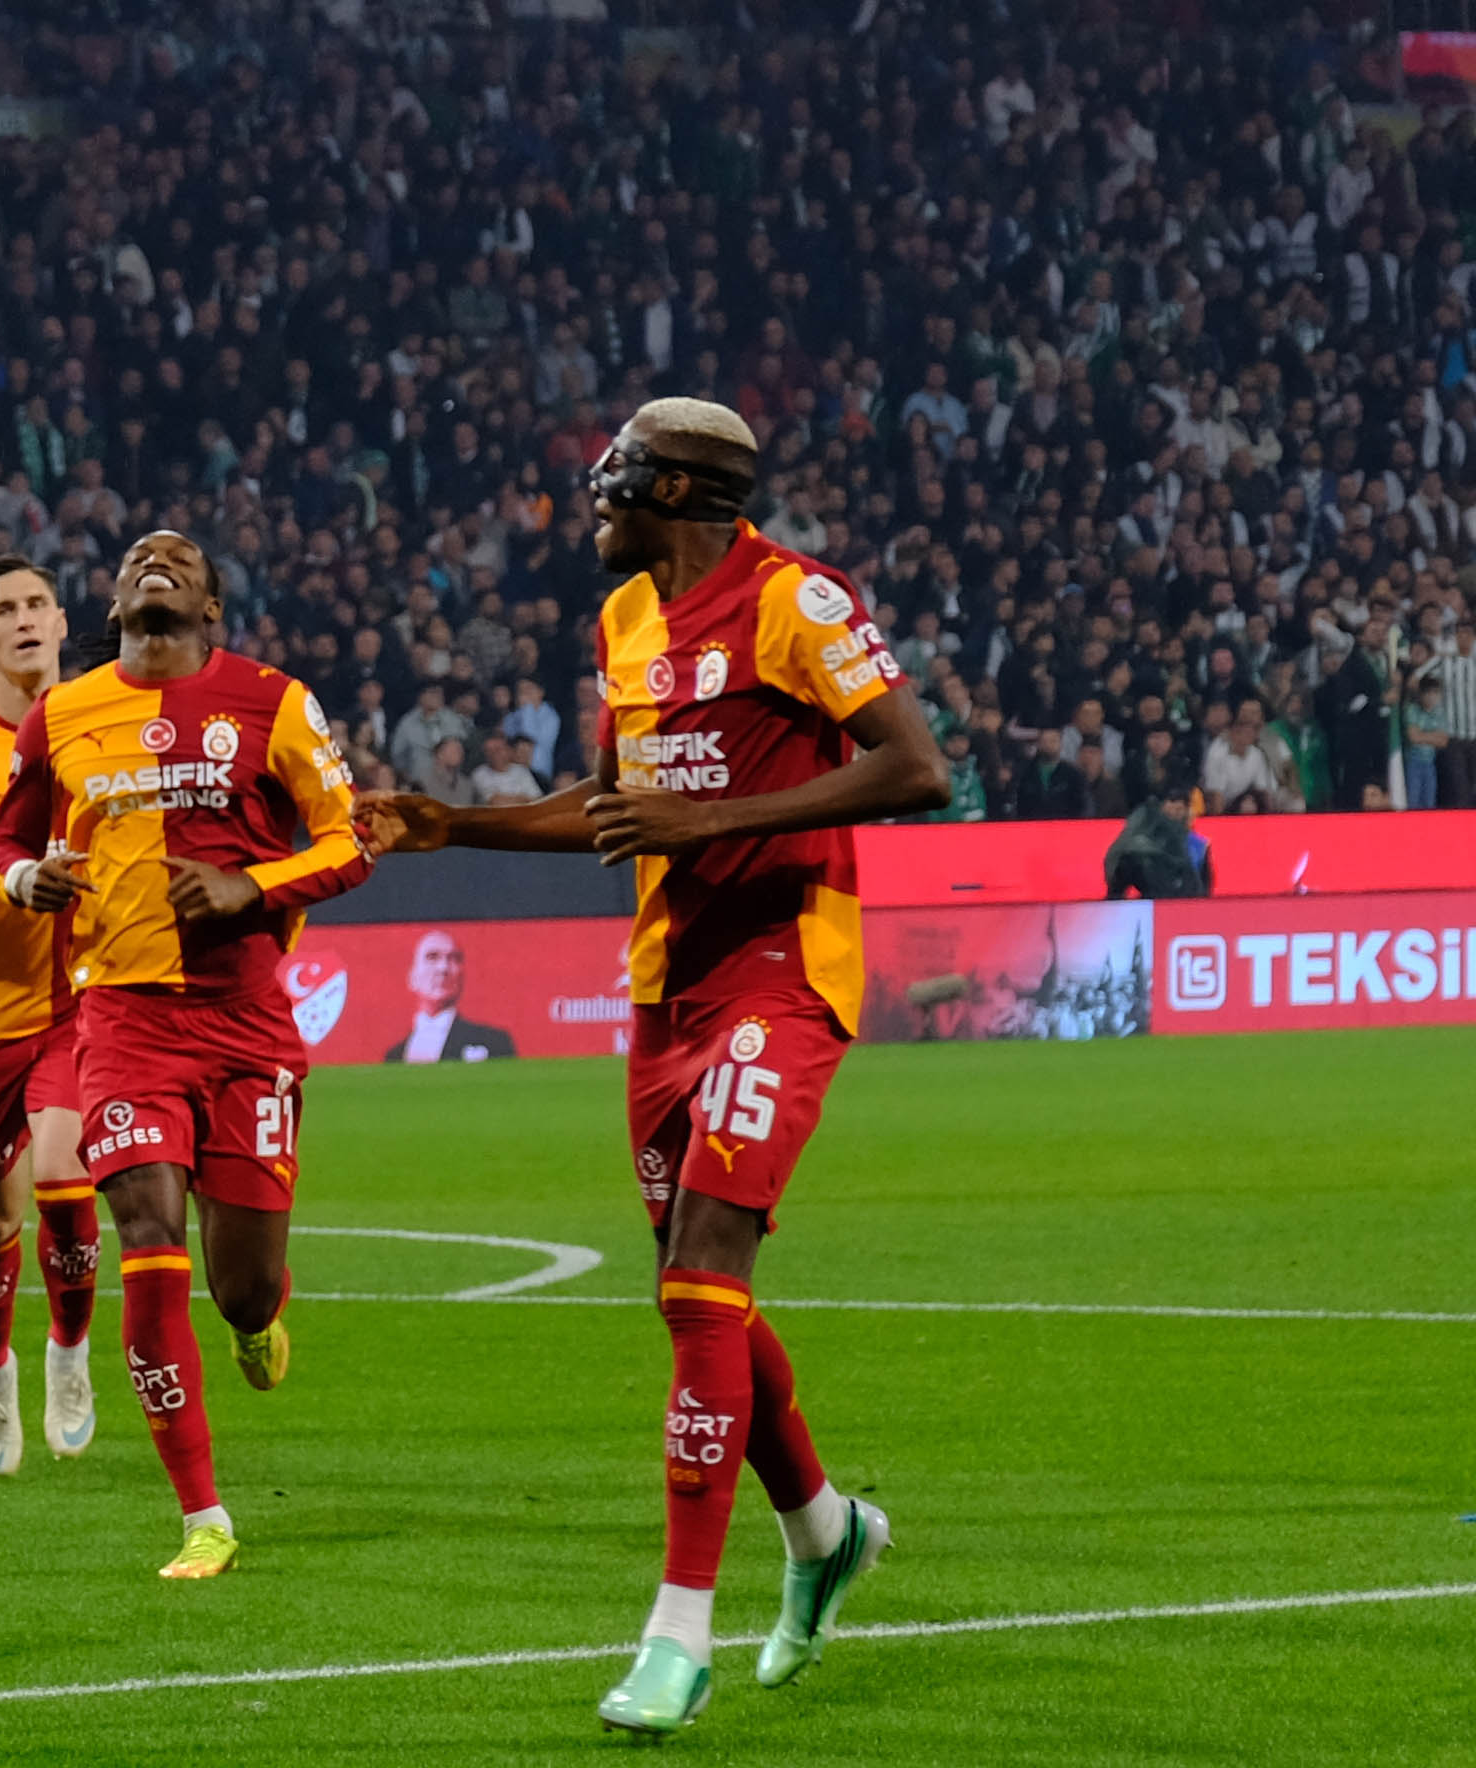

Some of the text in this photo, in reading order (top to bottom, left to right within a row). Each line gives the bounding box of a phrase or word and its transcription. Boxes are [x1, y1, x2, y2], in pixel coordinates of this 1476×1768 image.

[256, 1095, 293, 1157] 21
[701, 1062, 781, 1141] 45
[87, 1126, 163, 1162] REGES
